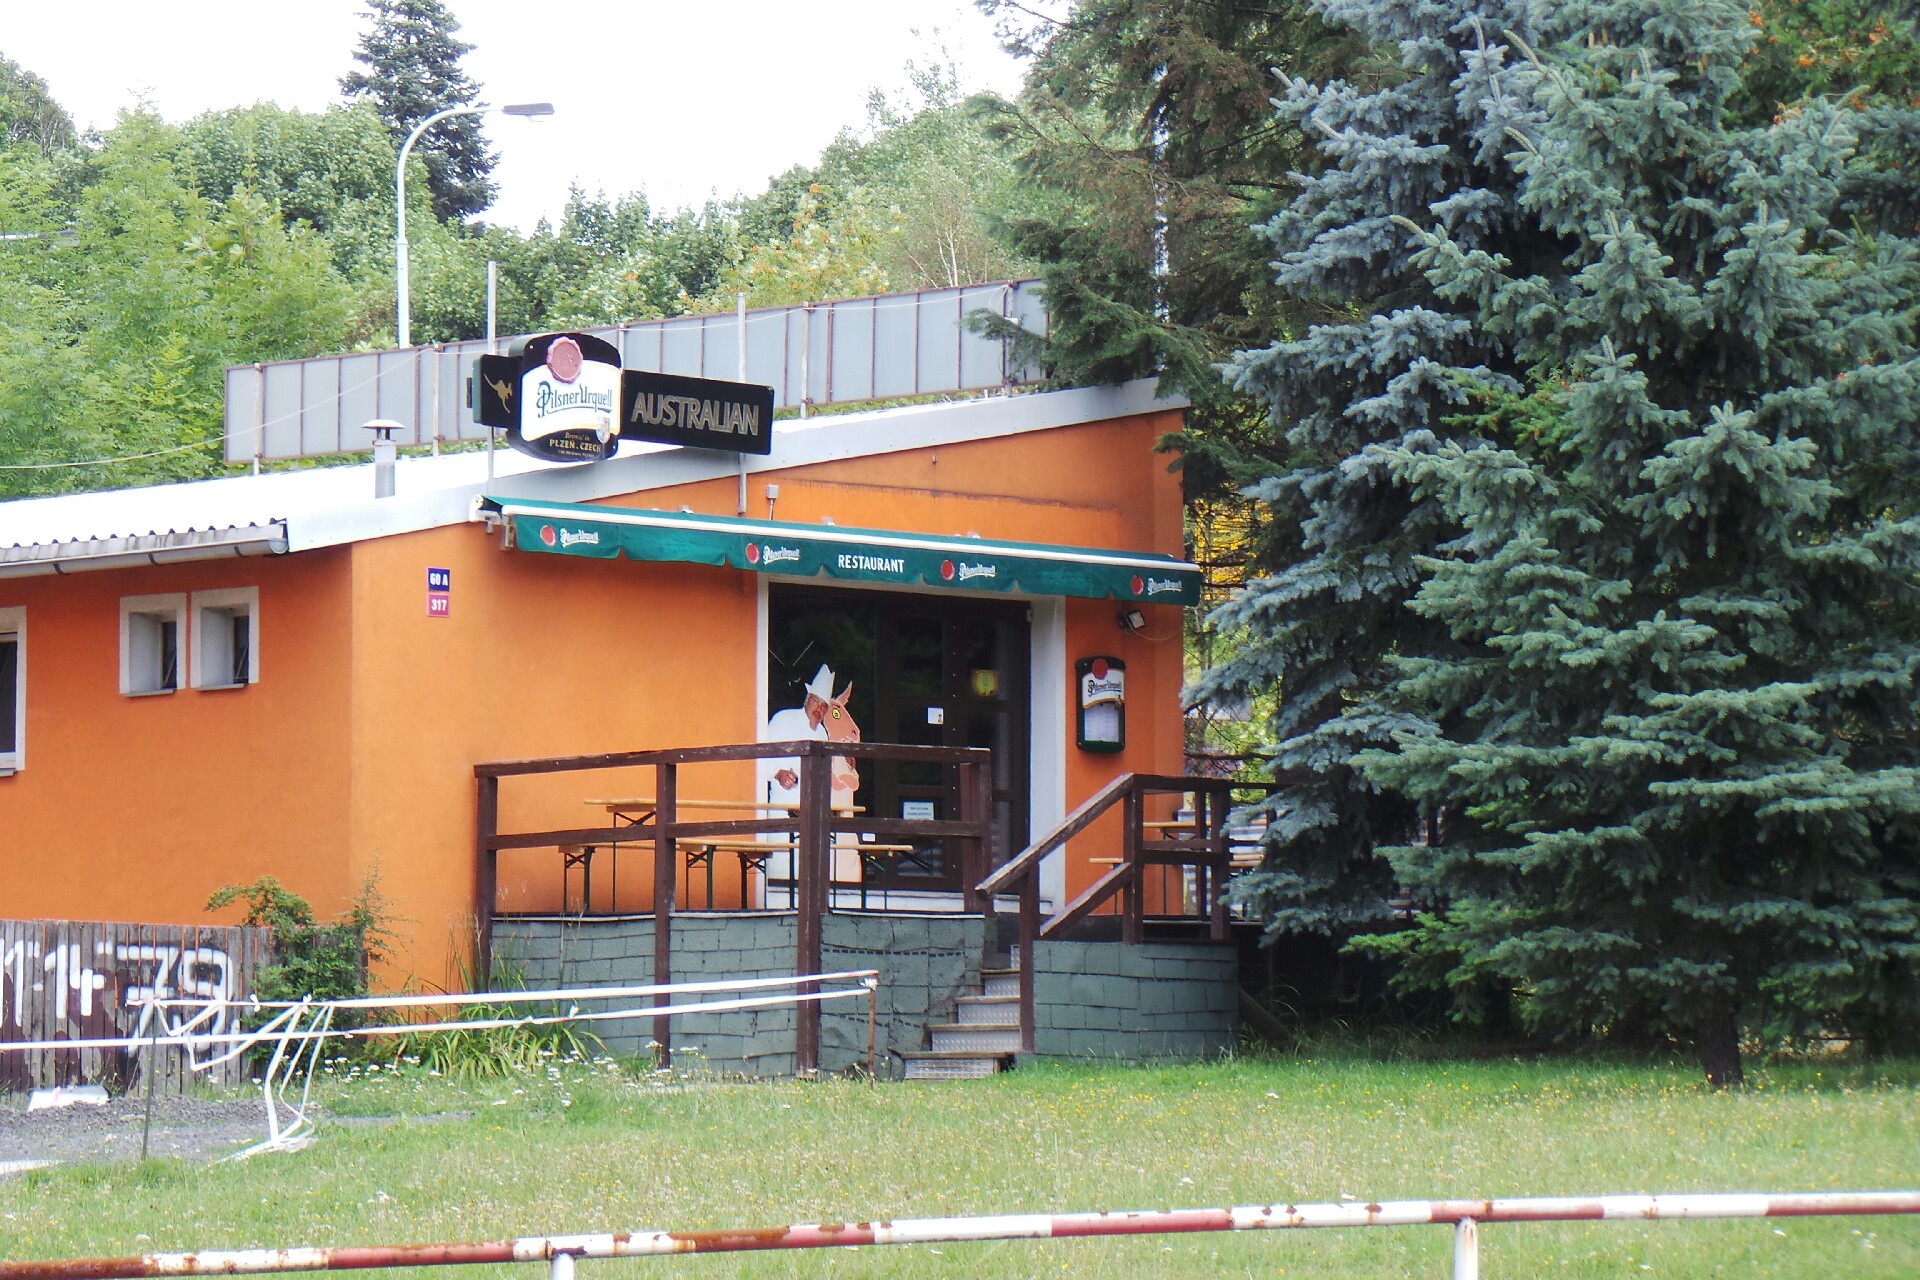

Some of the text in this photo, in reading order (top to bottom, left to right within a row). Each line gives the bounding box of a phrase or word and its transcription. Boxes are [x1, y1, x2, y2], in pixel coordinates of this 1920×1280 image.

[536, 380, 613, 418] Pilsner Urquell
[630, 392, 760, 436] AUSTRALIAN
[579, 442, 602, 453] CZECH
[838, 554, 905, 573] RESTAURANT
[430, 572, 449, 586] 60 A
[431, 598, 447, 611] 317
